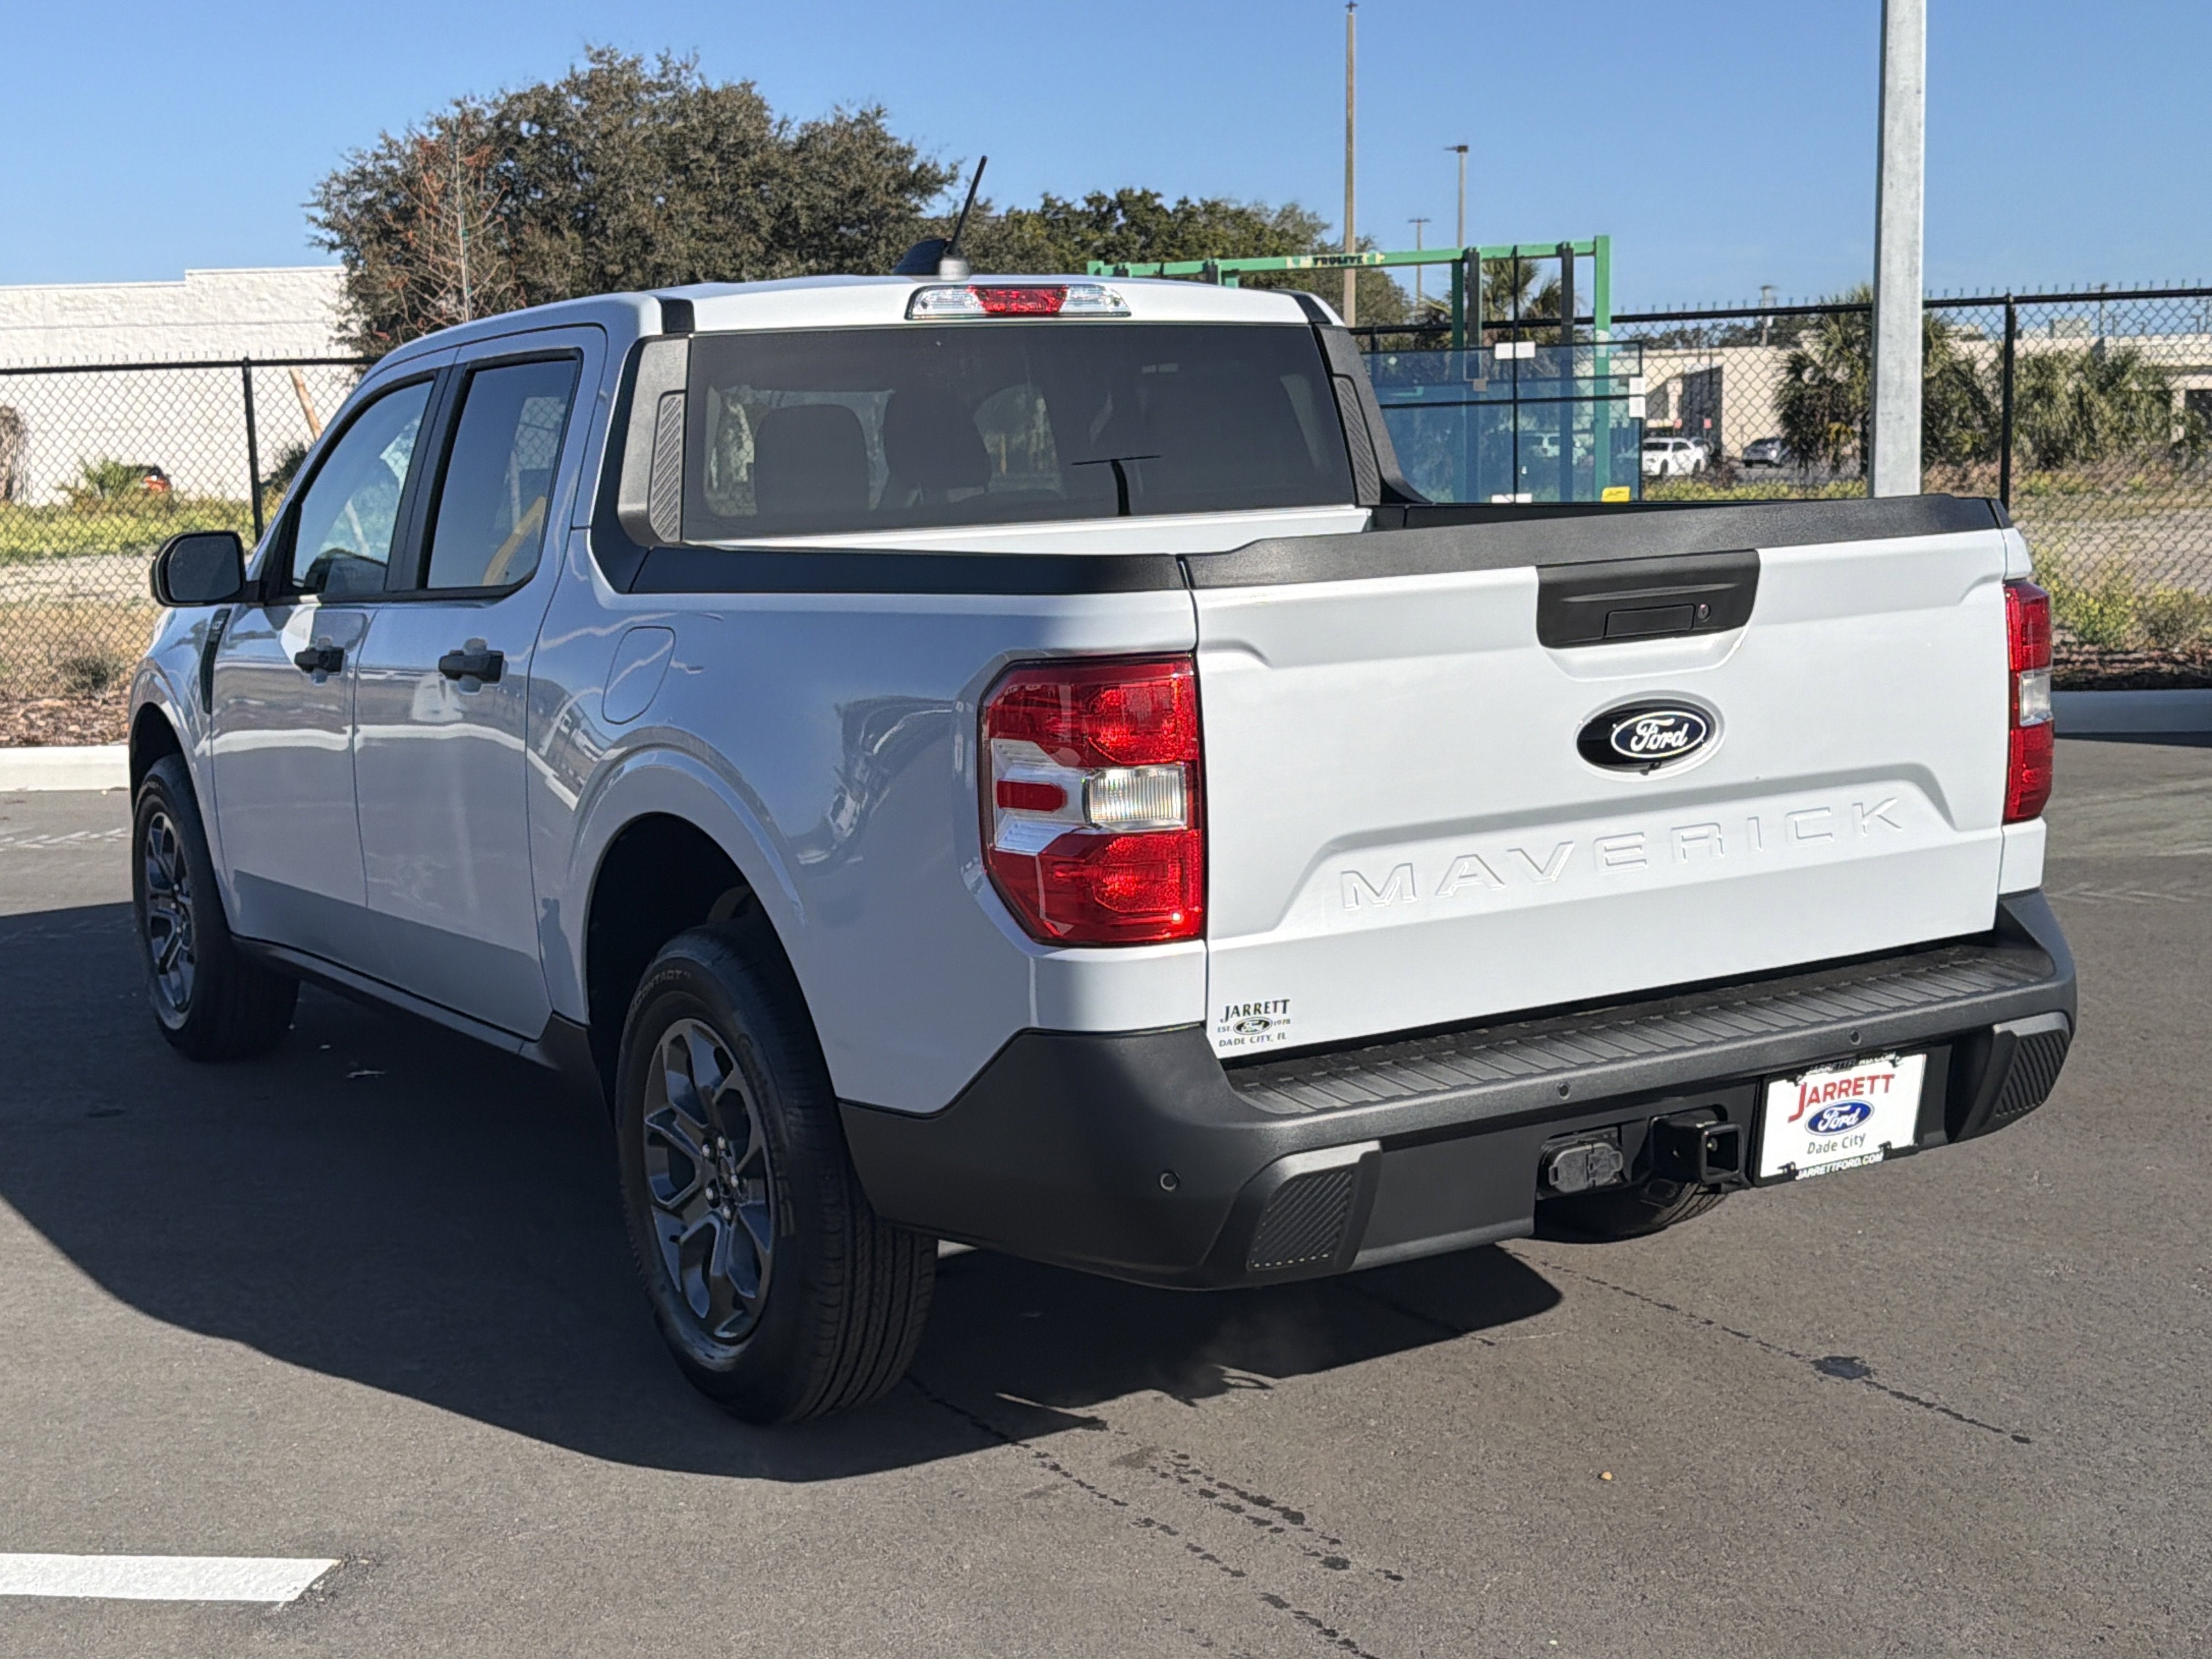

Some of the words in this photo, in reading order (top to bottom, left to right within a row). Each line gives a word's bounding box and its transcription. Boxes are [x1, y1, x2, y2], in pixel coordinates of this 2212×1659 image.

[1630, 718, 1689, 752] Ford
[1340, 797, 1903, 911] MAVERICK
[1220, 998, 1291, 1023] JARRETT
[1218, 1037, 1246, 1047] DADE
[1249, 1035, 1273, 1043] CITY,
[1277, 1032, 1287, 1040] FL
[1787, 1074, 1895, 1123] JARRETT
[1818, 1104, 1861, 1131] Ford
[1807, 1139, 1837, 1155] Dade
[1841, 1133, 1866, 1149] City
[1796, 1153, 1884, 1180] JARRETTFORD.COM
